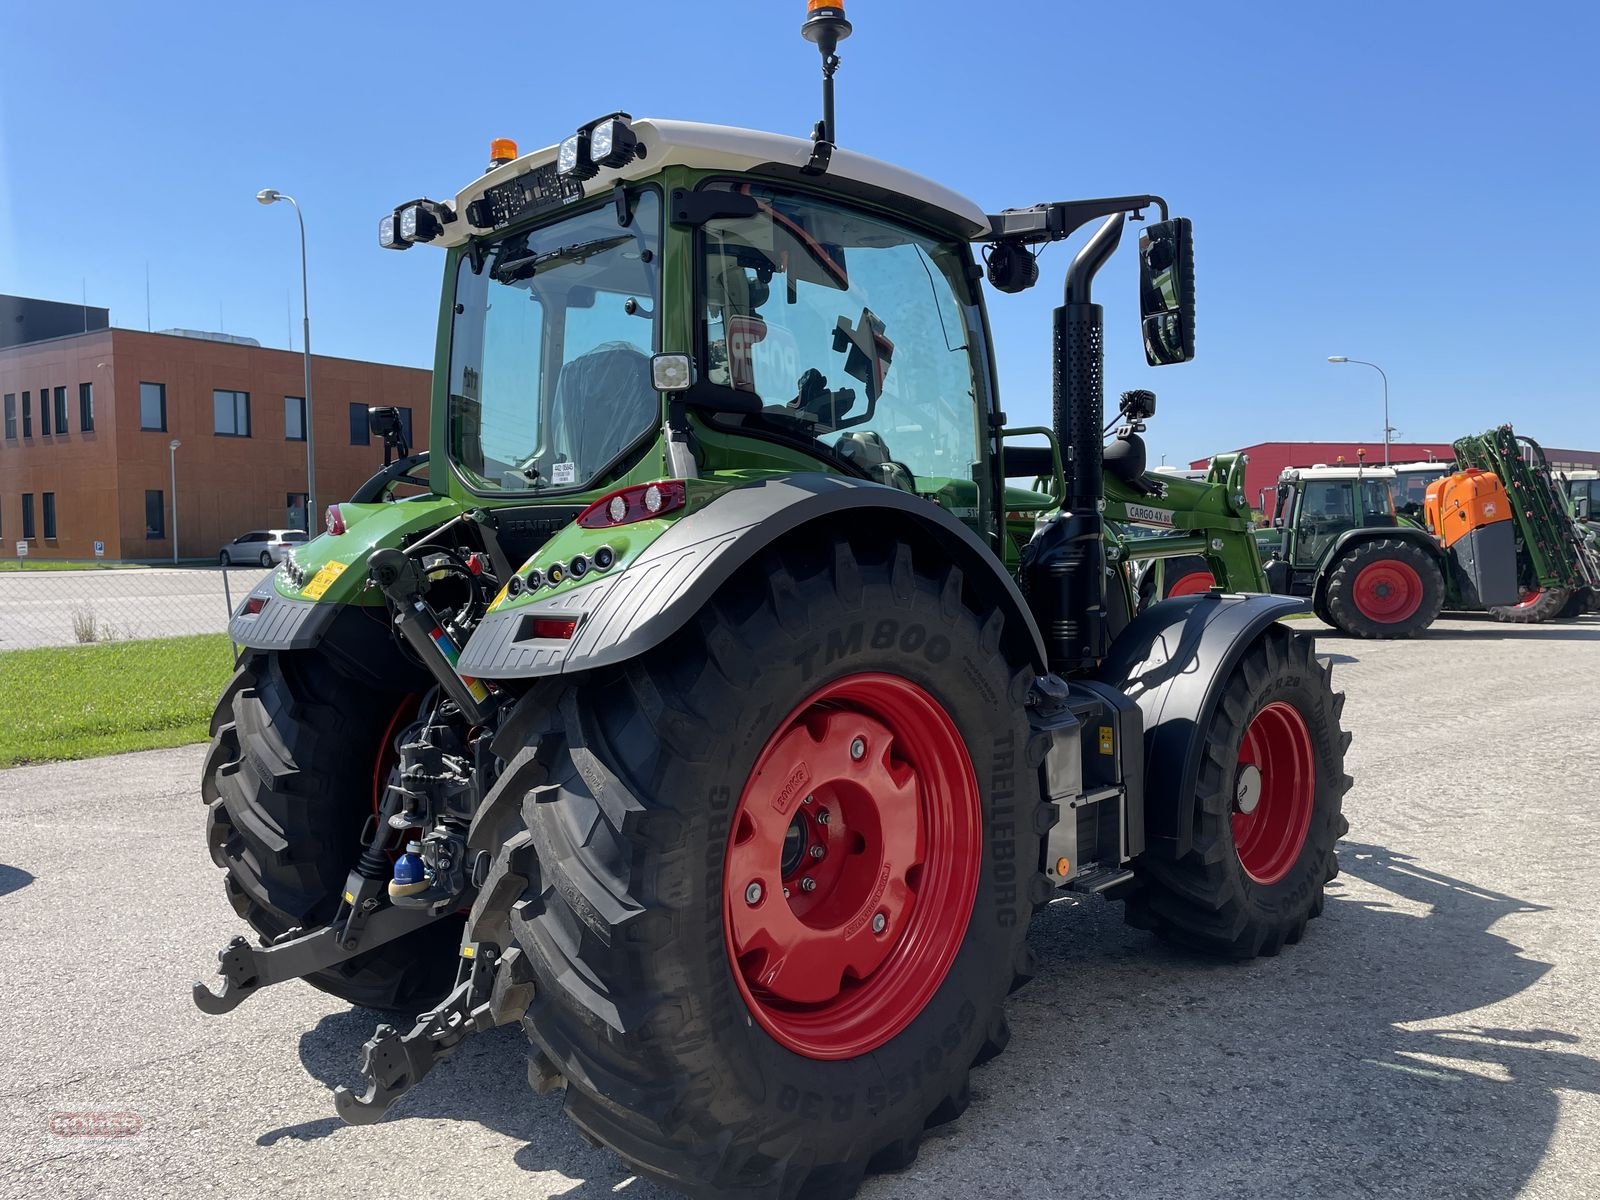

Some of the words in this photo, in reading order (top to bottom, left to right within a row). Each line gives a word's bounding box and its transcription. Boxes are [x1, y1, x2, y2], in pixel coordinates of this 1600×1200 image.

[1130, 507, 1154, 520] CARGO
[1155, 512, 1163, 522] 4X
[1285, 675, 1301, 688] 28
[991, 728, 1018, 929] TRELLEBORG
[704, 784, 733, 1042] TRELLEBORG
[776, 1083, 824, 1121] 38
